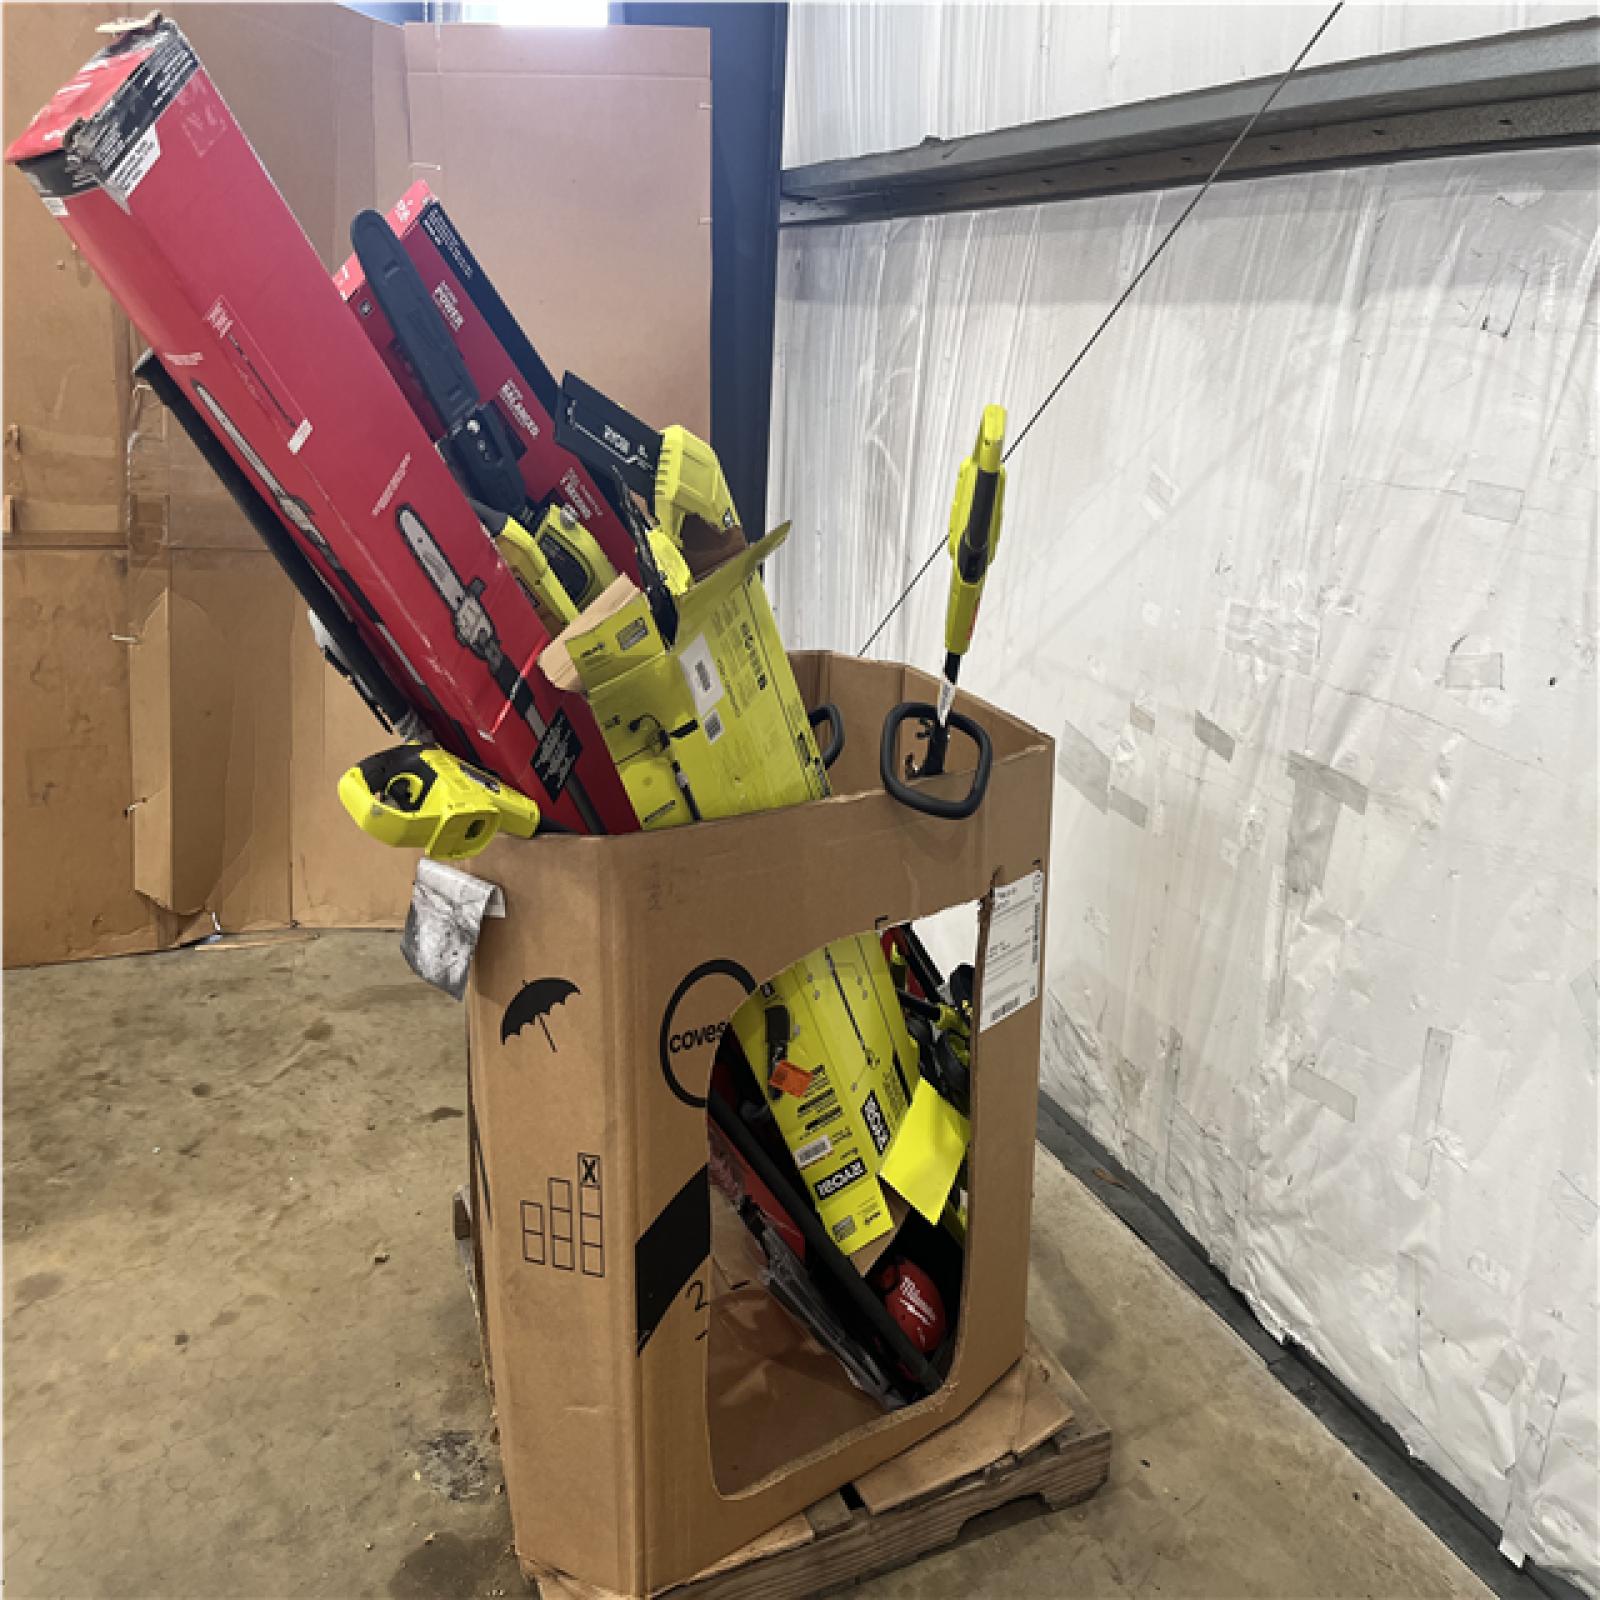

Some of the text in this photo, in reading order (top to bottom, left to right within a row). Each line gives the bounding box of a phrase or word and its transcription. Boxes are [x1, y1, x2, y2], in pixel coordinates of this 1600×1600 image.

[433, 284, 465, 328] POWER
[863, 1096, 891, 1152] RYOBI
[817, 1161, 865, 1197] RYOBI
